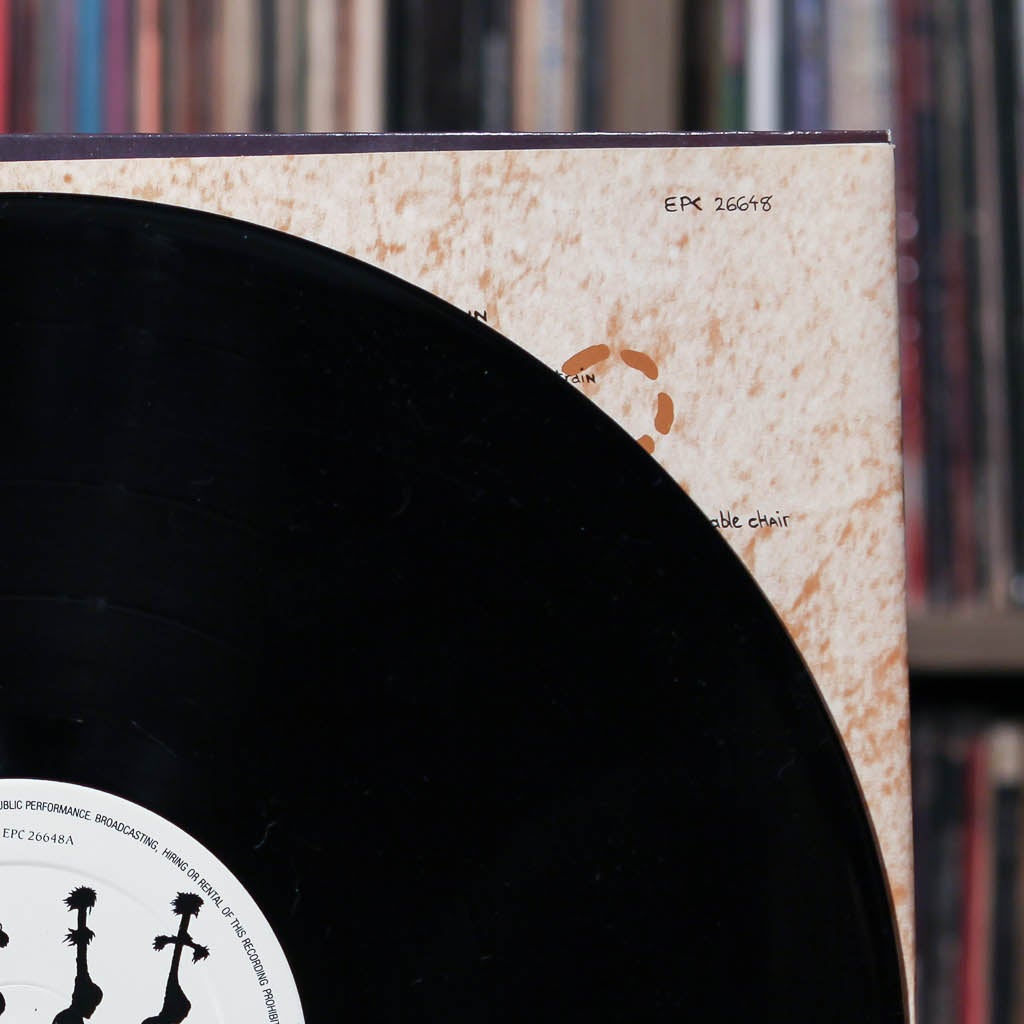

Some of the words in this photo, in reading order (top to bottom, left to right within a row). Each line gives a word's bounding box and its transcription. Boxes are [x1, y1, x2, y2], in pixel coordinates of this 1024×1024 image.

[714, 195, 773, 212] 26648
[2, 827, 25, 841] EPC
[27, 830, 74, 846] 26648A
[94, 813, 160, 853] BROADCASTING,
[161, 847, 189, 873] HIRING
[186, 868, 200, 882] OR
[197, 878, 224, 909] RENTAL
[221, 906, 235, 919] OF
[230, 918, 247, 938] THIS
[241, 937, 269, 987] RECORDING
